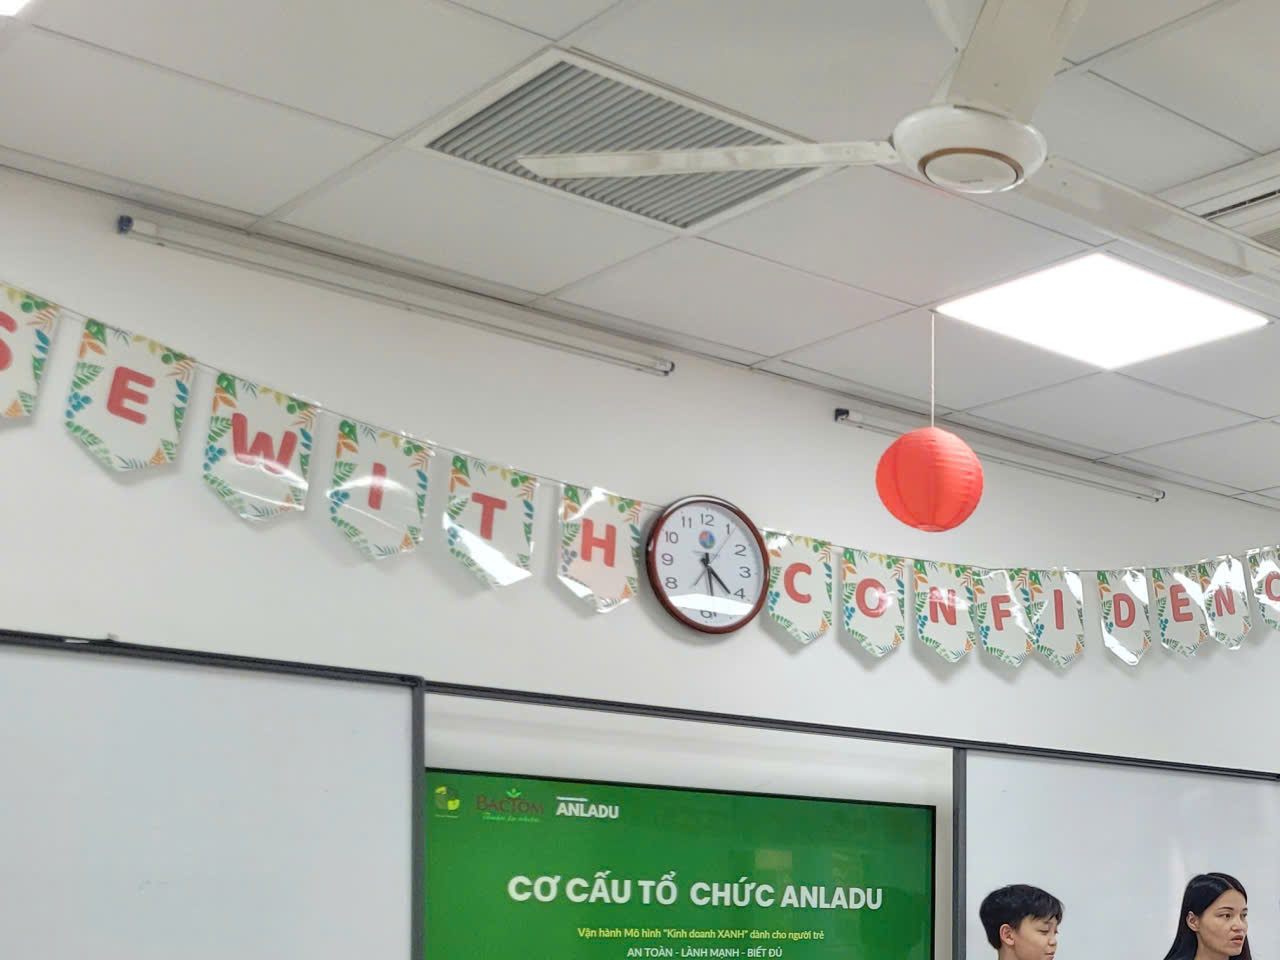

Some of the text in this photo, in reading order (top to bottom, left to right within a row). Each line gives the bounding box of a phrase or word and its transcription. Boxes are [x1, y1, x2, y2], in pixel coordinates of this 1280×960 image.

[231, 412, 617, 568] WITH
[681, 515, 693, 529] 11
[700, 513, 715, 527] 12
[725, 522, 732, 535] 1
[665, 531, 679, 544] 10
[735, 544, 747, 557] 2
[661, 553, 674, 566] 9
[739, 566, 752, 579] 3
[665, 576, 678, 590] 8
[733, 587, 747, 600] 4
[555, 802, 620, 819] ANLADU
[507, 870, 883, 911] CƠ CẤU TỔ CHỨC ANLADU
[577, 927, 597, 939] Vận
[599, 927, 622, 938] hành
[624, 928, 640, 938] Mô
[642, 928, 661, 939] hình
[689, 929, 716, 939] doanh
[750, 929, 770, 940] dành
[771, 930, 787, 940] cho
[788, 930, 812, 942] người
[813, 930, 825, 940] trẻ
[627, 948, 643, 958] AN
[644, 947, 673, 958] TOÀN
[681, 947, 709, 958] LÀNH
[710, 947, 740, 960] MẠNH
[747, 946, 768, 958] BIẾT
[768, 947, 783, 958] ĐỦ
